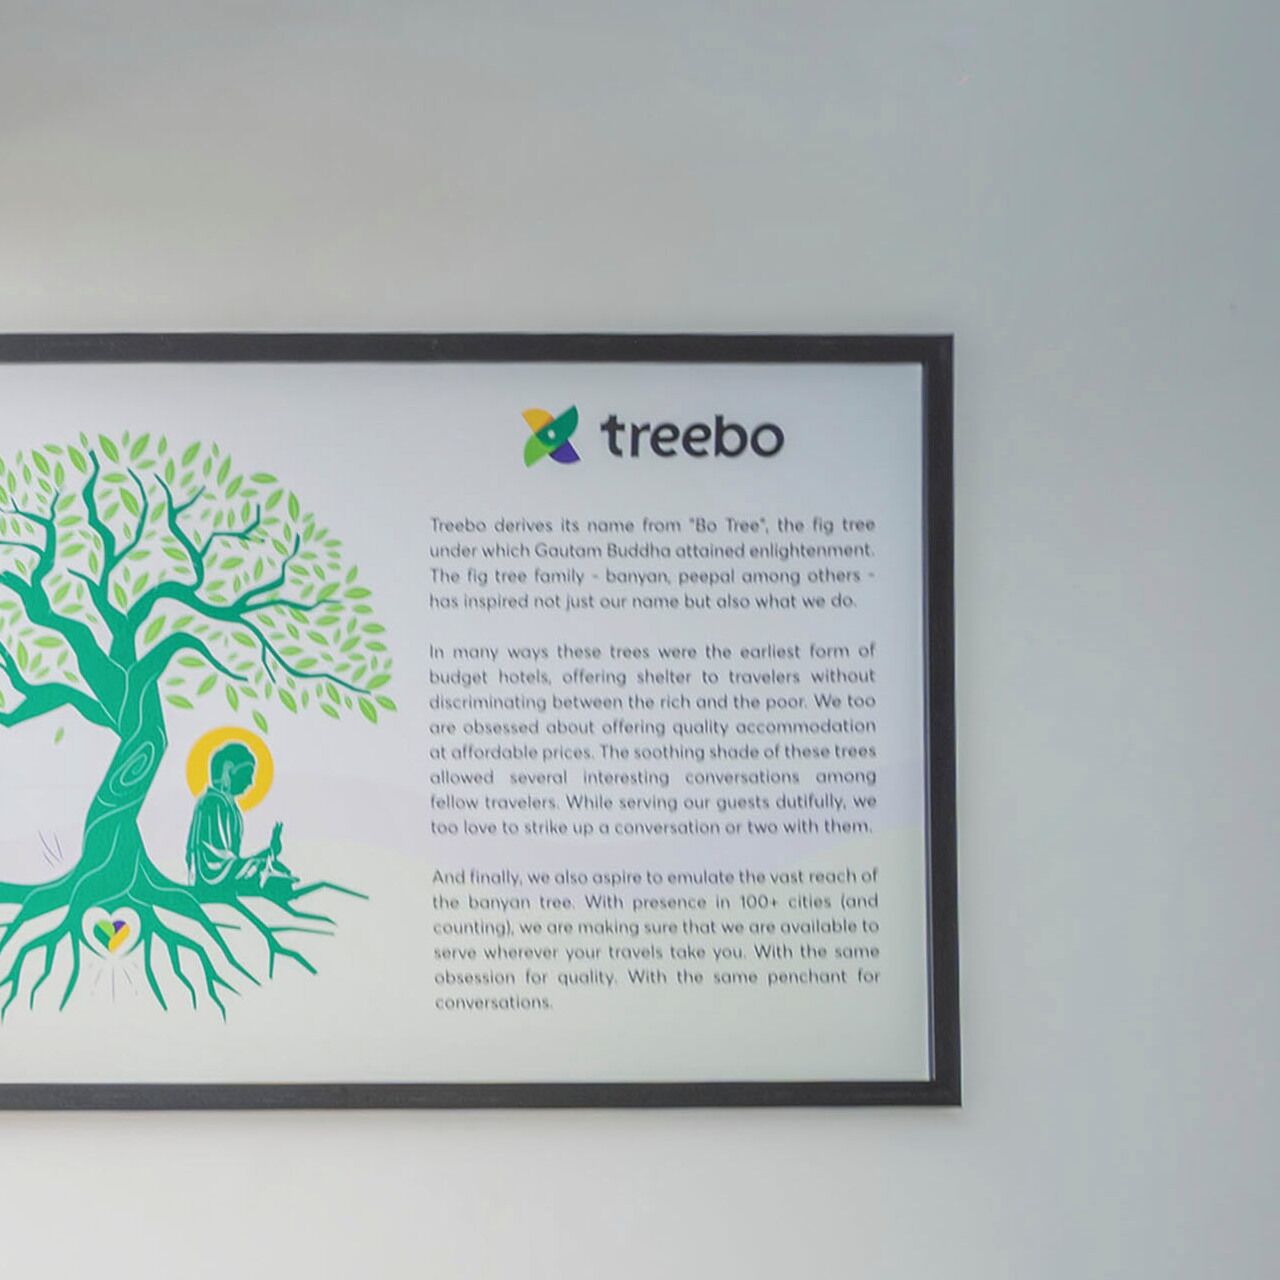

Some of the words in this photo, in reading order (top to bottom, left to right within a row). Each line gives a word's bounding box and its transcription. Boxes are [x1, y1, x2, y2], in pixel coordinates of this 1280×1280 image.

[600, 414, 784, 458] treebo
[431, 518, 487, 532] Treebo
[494, 518, 553, 532] derives
[560, 518, 580, 532] its
[587, 521, 635, 532] name
[642, 517, 682, 532] from
[777, 517, 805, 533] the
[812, 516, 835, 536] fig
[841, 517, 877, 532] tree
[429, 543, 477, 557] under
[481, 543, 531, 557] which
[534, 543, 603, 558] Gautam
[606, 542, 672, 558] Buddha
[674, 543, 746, 558] attained
[749, 542, 875, 562] enlightenment.
[431, 568, 461, 582] The
[467, 568, 488, 586] fig
[494, 570, 528, 583] tree
[534, 568, 585, 586] family
[605, 568, 672, 586] banyan,
[678, 568, 735, 586] peepal
[741, 571, 801, 587] among
[807, 567, 861, 583] others
[429, 645, 445, 658] In
[453, 648, 499, 661] many
[507, 648, 549, 661] ways
[557, 644, 602, 659] these
[609, 645, 651, 659] trees
[657, 648, 698, 659] were
[705, 643, 732, 659] the
[739, 644, 801, 659] earliest
[809, 643, 850, 659] form
[857, 641, 877, 658] of
[429, 670, 488, 687] budget
[498, 669, 552, 685] hotels,
[562, 669, 627, 687] offering
[636, 669, 692, 684] shelter
[701, 670, 720, 684] to
[728, 669, 801, 684] travelers
[810, 667, 876, 683] without
[429, 695, 547, 712] discriminating
[552, 695, 623, 709] between
[628, 694, 655, 709] the
[660, 694, 691, 709] rich
[695, 694, 728, 709] and
[732, 694, 761, 709] the
[765, 697, 808, 712] poor.
[813, 693, 843, 708] We
[847, 694, 877, 708] too
[429, 724, 457, 734] are
[463, 720, 539, 734] obsessed
[545, 720, 595, 734] about
[601, 719, 666, 737] offering
[672, 719, 729, 737] quality
[735, 718, 877, 734] accommodation
[429, 747, 446, 759] at
[451, 744, 539, 759] affordable
[542, 746, 594, 762] prices.
[599, 744, 630, 759] The
[633, 744, 706, 762] soothing
[709, 744, 760, 759] shade
[763, 743, 781, 759] of
[784, 743, 831, 759] these
[834, 744, 877, 758] trees
[429, 770, 494, 784] allowed
[509, 770, 568, 784] several
[583, 771, 670, 787] interesting
[684, 769, 800, 785] conversations
[815, 771, 877, 787] among
[430, 795, 479, 809] fellow
[484, 795, 560, 809] travelers.
[565, 794, 614, 809] While
[619, 796, 678, 813] serving
[683, 798, 711, 809] our
[716, 795, 770, 812] guests
[775, 792, 847, 812] dutifully,
[852, 796, 878, 808] we
[432, 895, 460, 909] the
[468, 895, 531, 912] banyan
[539, 896, 575, 909] tree.
[584, 894, 624, 909] With
[632, 898, 707, 912] presence
[715, 895, 731, 909] in
[740, 894, 779, 909] 100+
[788, 894, 832, 909] cities
[840, 892, 879, 911] (and
[433, 920, 515, 937] counting),
[519, 924, 543, 933] we
[546, 924, 574, 934] are
[578, 920, 640, 937] making
[643, 923, 678, 934] sure
[682, 919, 717, 934] that
[720, 923, 745, 933] we
[748, 923, 776, 934] are
[779, 918, 858, 934] available
[861, 919, 880, 933] to
[433, 950, 477, 959] serve
[483, 945, 557, 959] wherever
[565, 949, 600, 961] your
[608, 944, 664, 959] travels
[669, 944, 706, 960] take
[712, 948, 746, 962] you.
[753, 944, 794, 959] With
[799, 943, 828, 959] the
[834, 947, 881, 959] same
[434, 970, 516, 984] obsession
[525, 969, 547, 984] for
[557, 969, 618, 986] quality.
[627, 970, 668, 984] With
[676, 969, 704, 984] the
[713, 973, 758, 984] same
[767, 968, 848, 987] penchant
[857, 967, 881, 984] for
[435, 996, 553, 1009] conversations.
